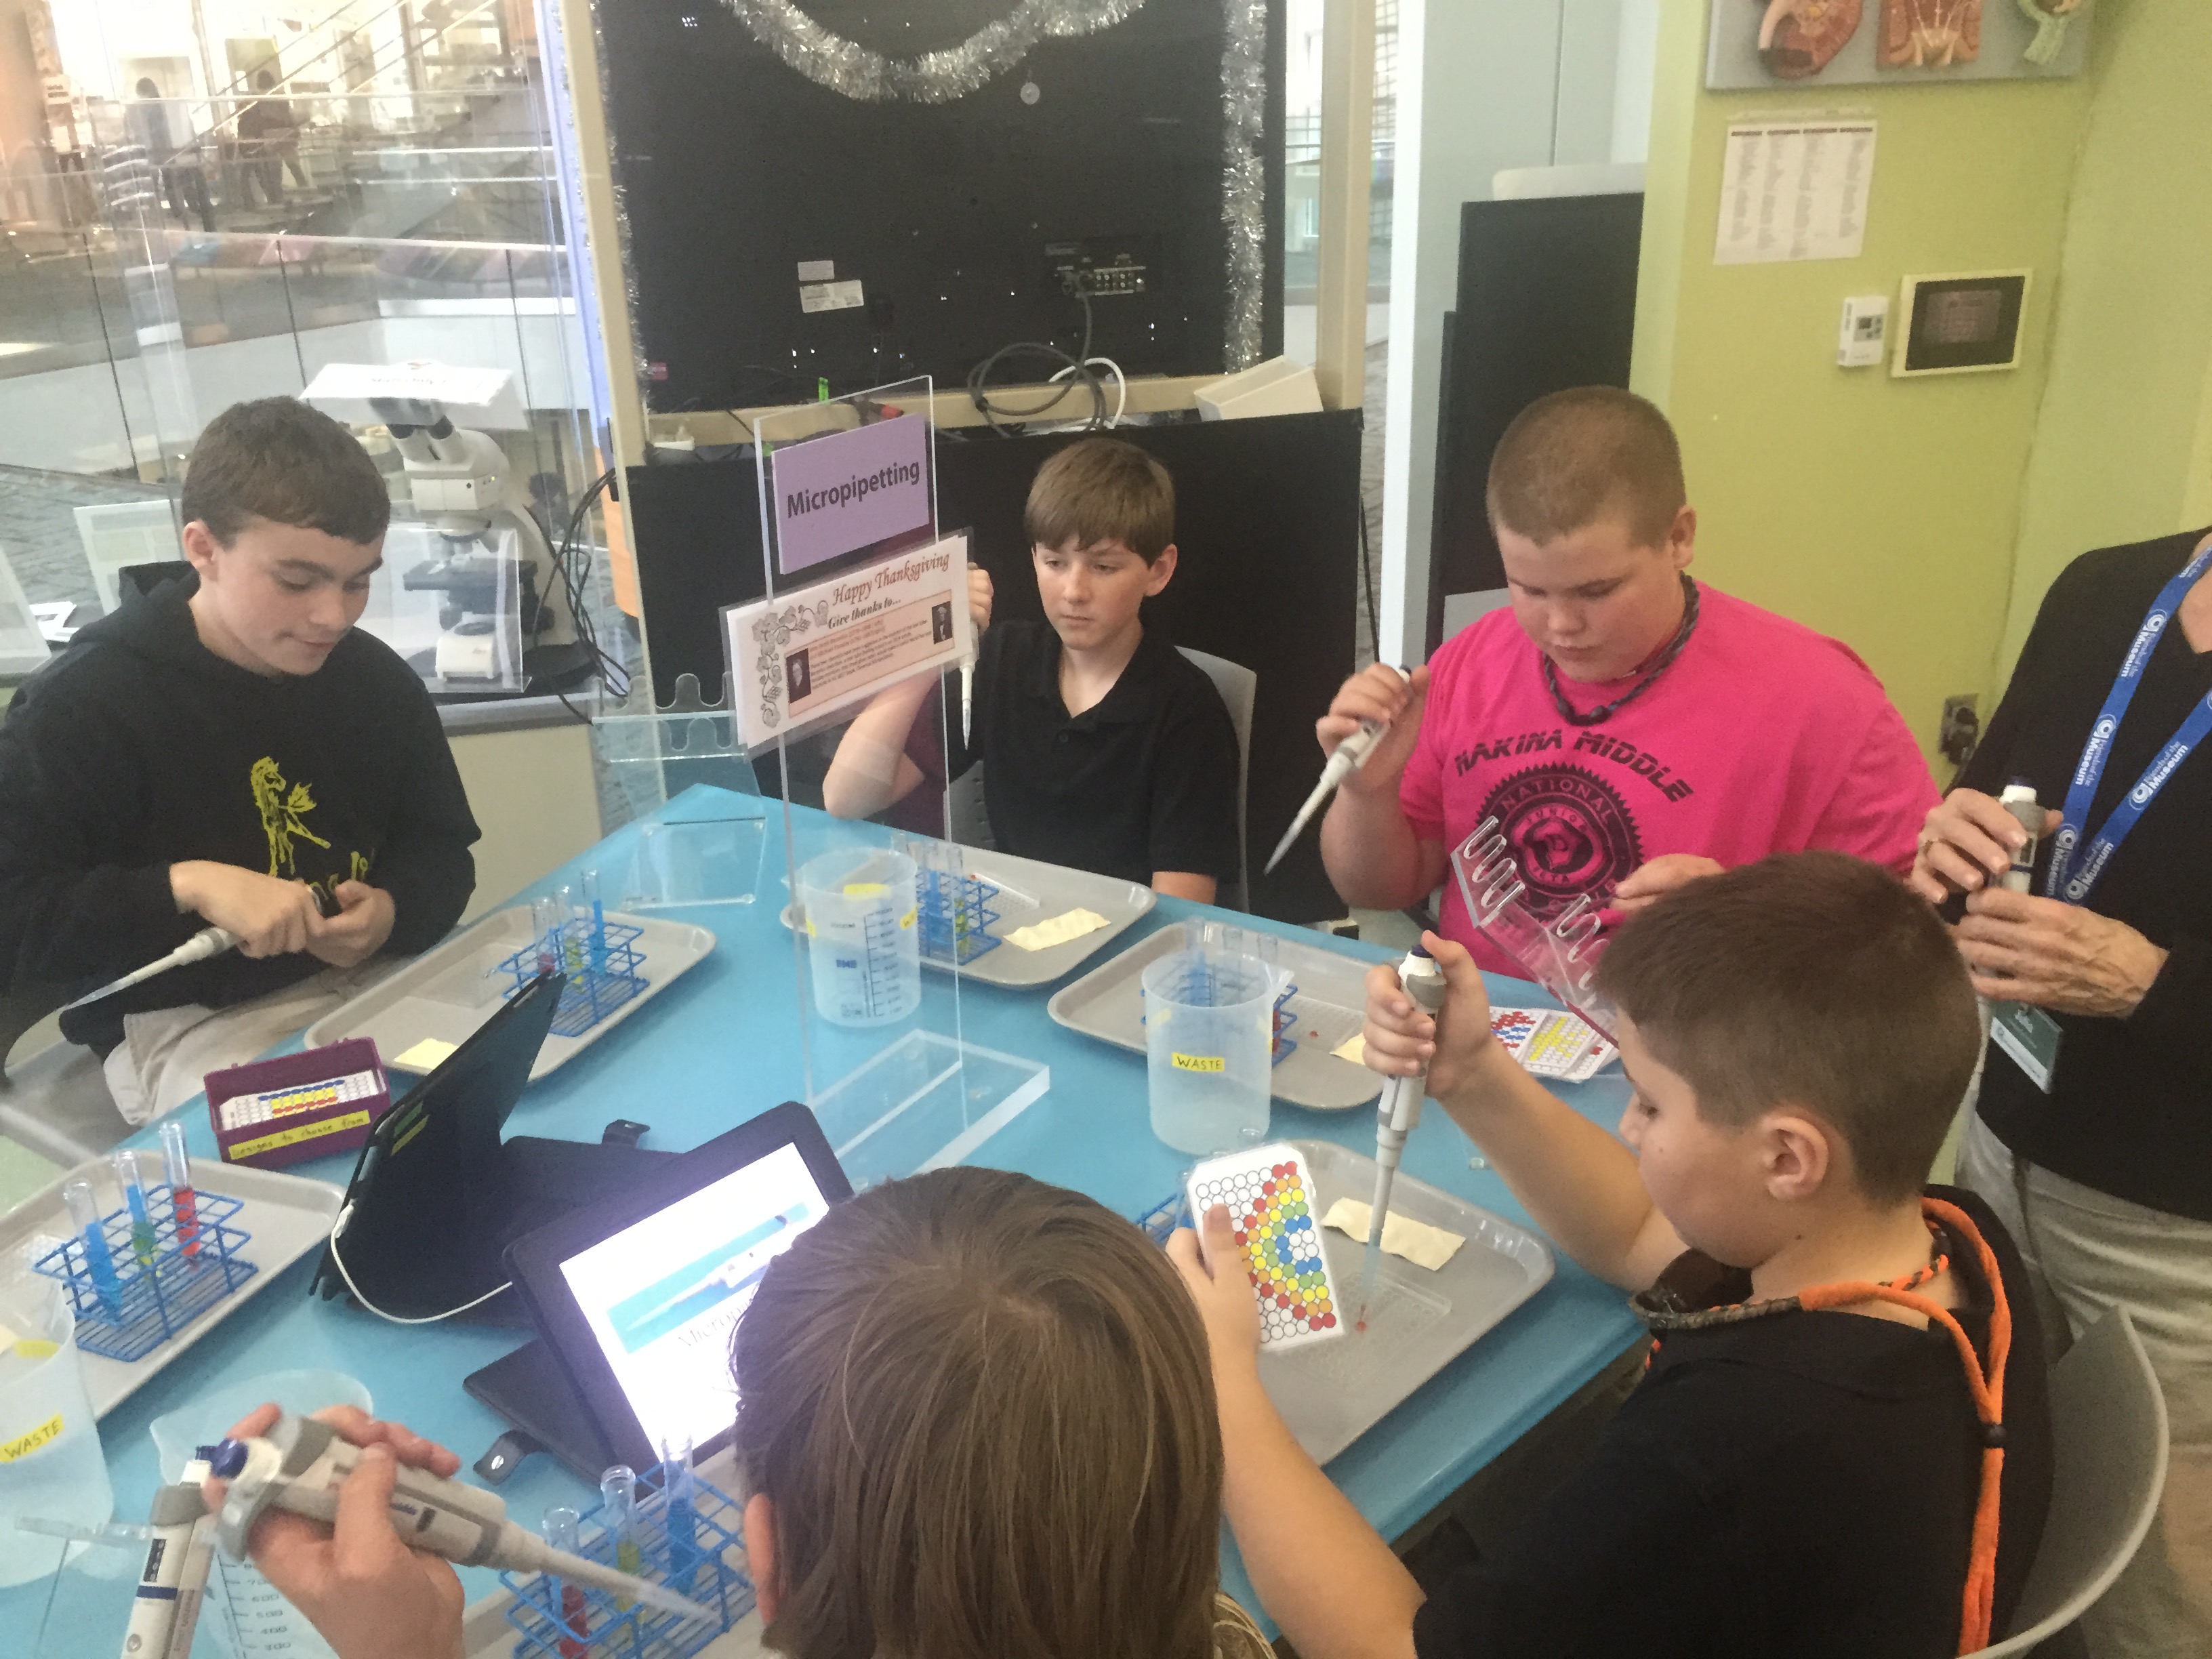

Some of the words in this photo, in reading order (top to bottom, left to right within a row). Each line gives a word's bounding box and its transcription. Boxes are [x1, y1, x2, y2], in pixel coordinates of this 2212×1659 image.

[787, 462, 920, 518] Micropipetting
[833, 579, 872, 607] Happy
[874, 553, 950, 589] Thanksgiving
[828, 613, 848, 630] Give
[851, 600, 882, 620] thanks
[2121, 632, 2149, 677] Museum
[1574, 730, 1695, 802] MIDDLE
[2075, 737, 2101, 785] Museum
[2148, 745, 2188, 790] Museum
[1501, 779, 1612, 825] NATIONAL
[2083, 842, 2114, 886] Museum
[1177, 1056, 1222, 1070] WASTE
[4, 1420, 60, 1459] WASTE
